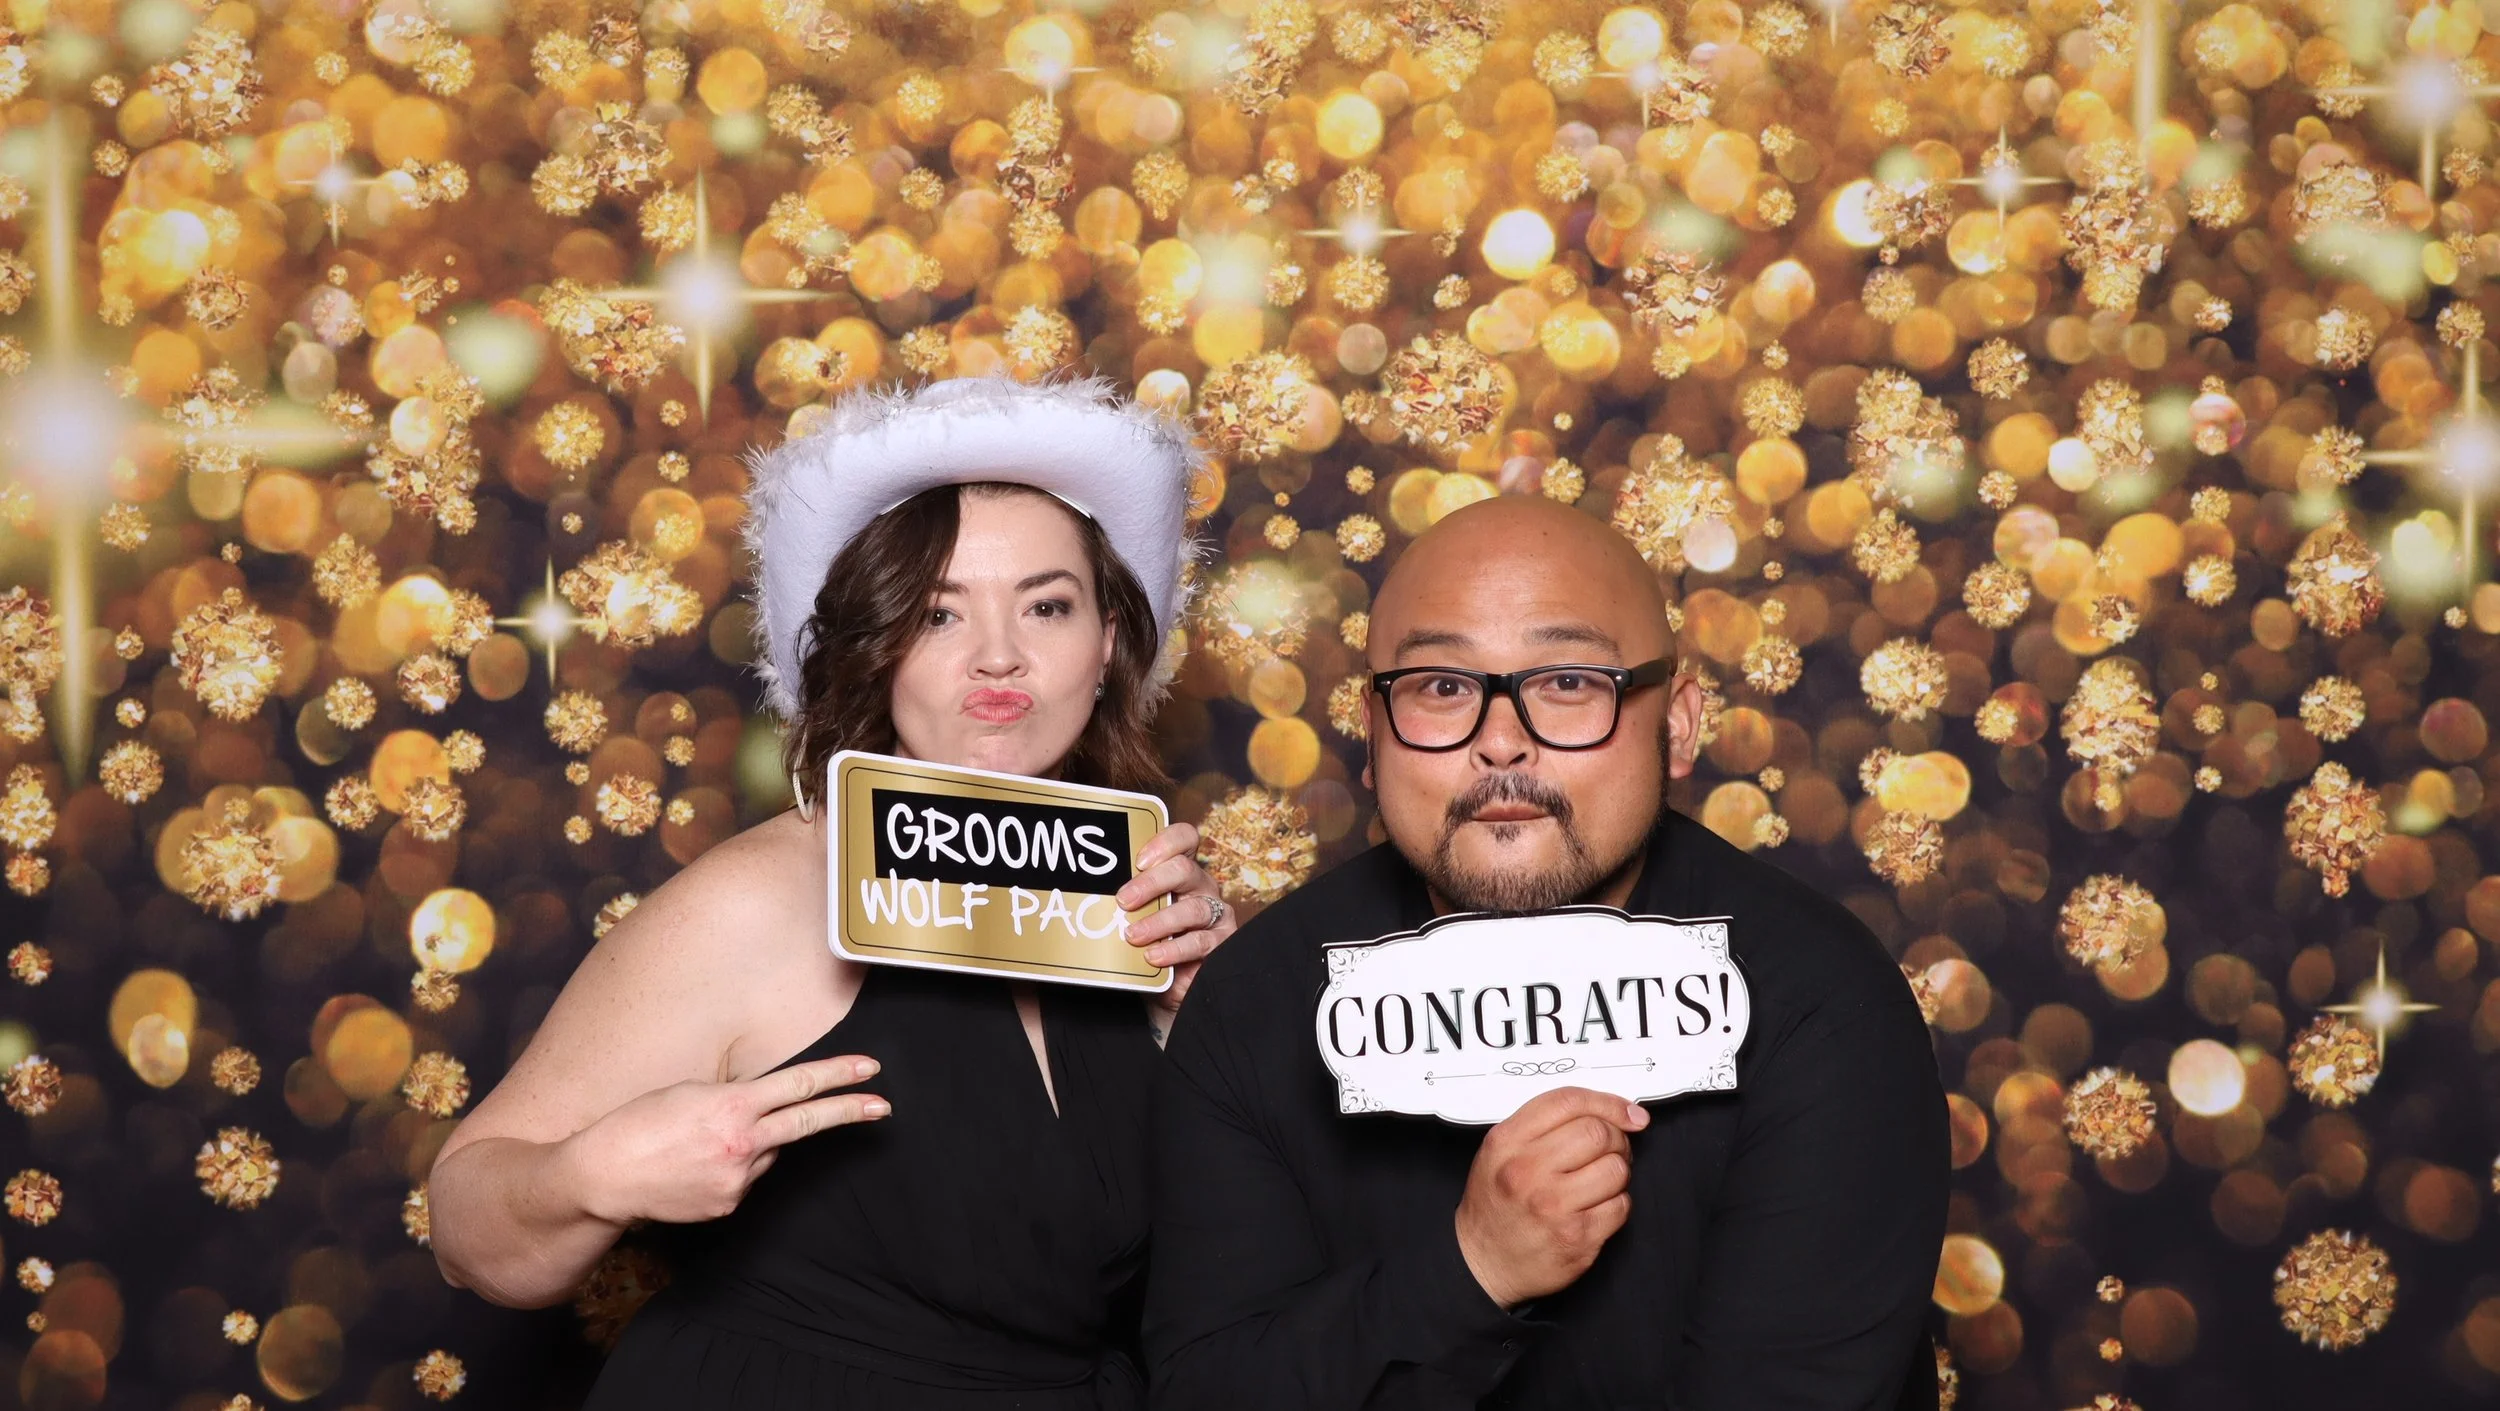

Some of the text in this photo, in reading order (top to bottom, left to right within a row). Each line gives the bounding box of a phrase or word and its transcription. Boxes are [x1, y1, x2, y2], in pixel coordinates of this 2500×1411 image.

[886, 802, 1118, 875] GROOMS
[860, 868, 989, 931] WOLF
[1329, 973, 1732, 1058] CONGRATS!
